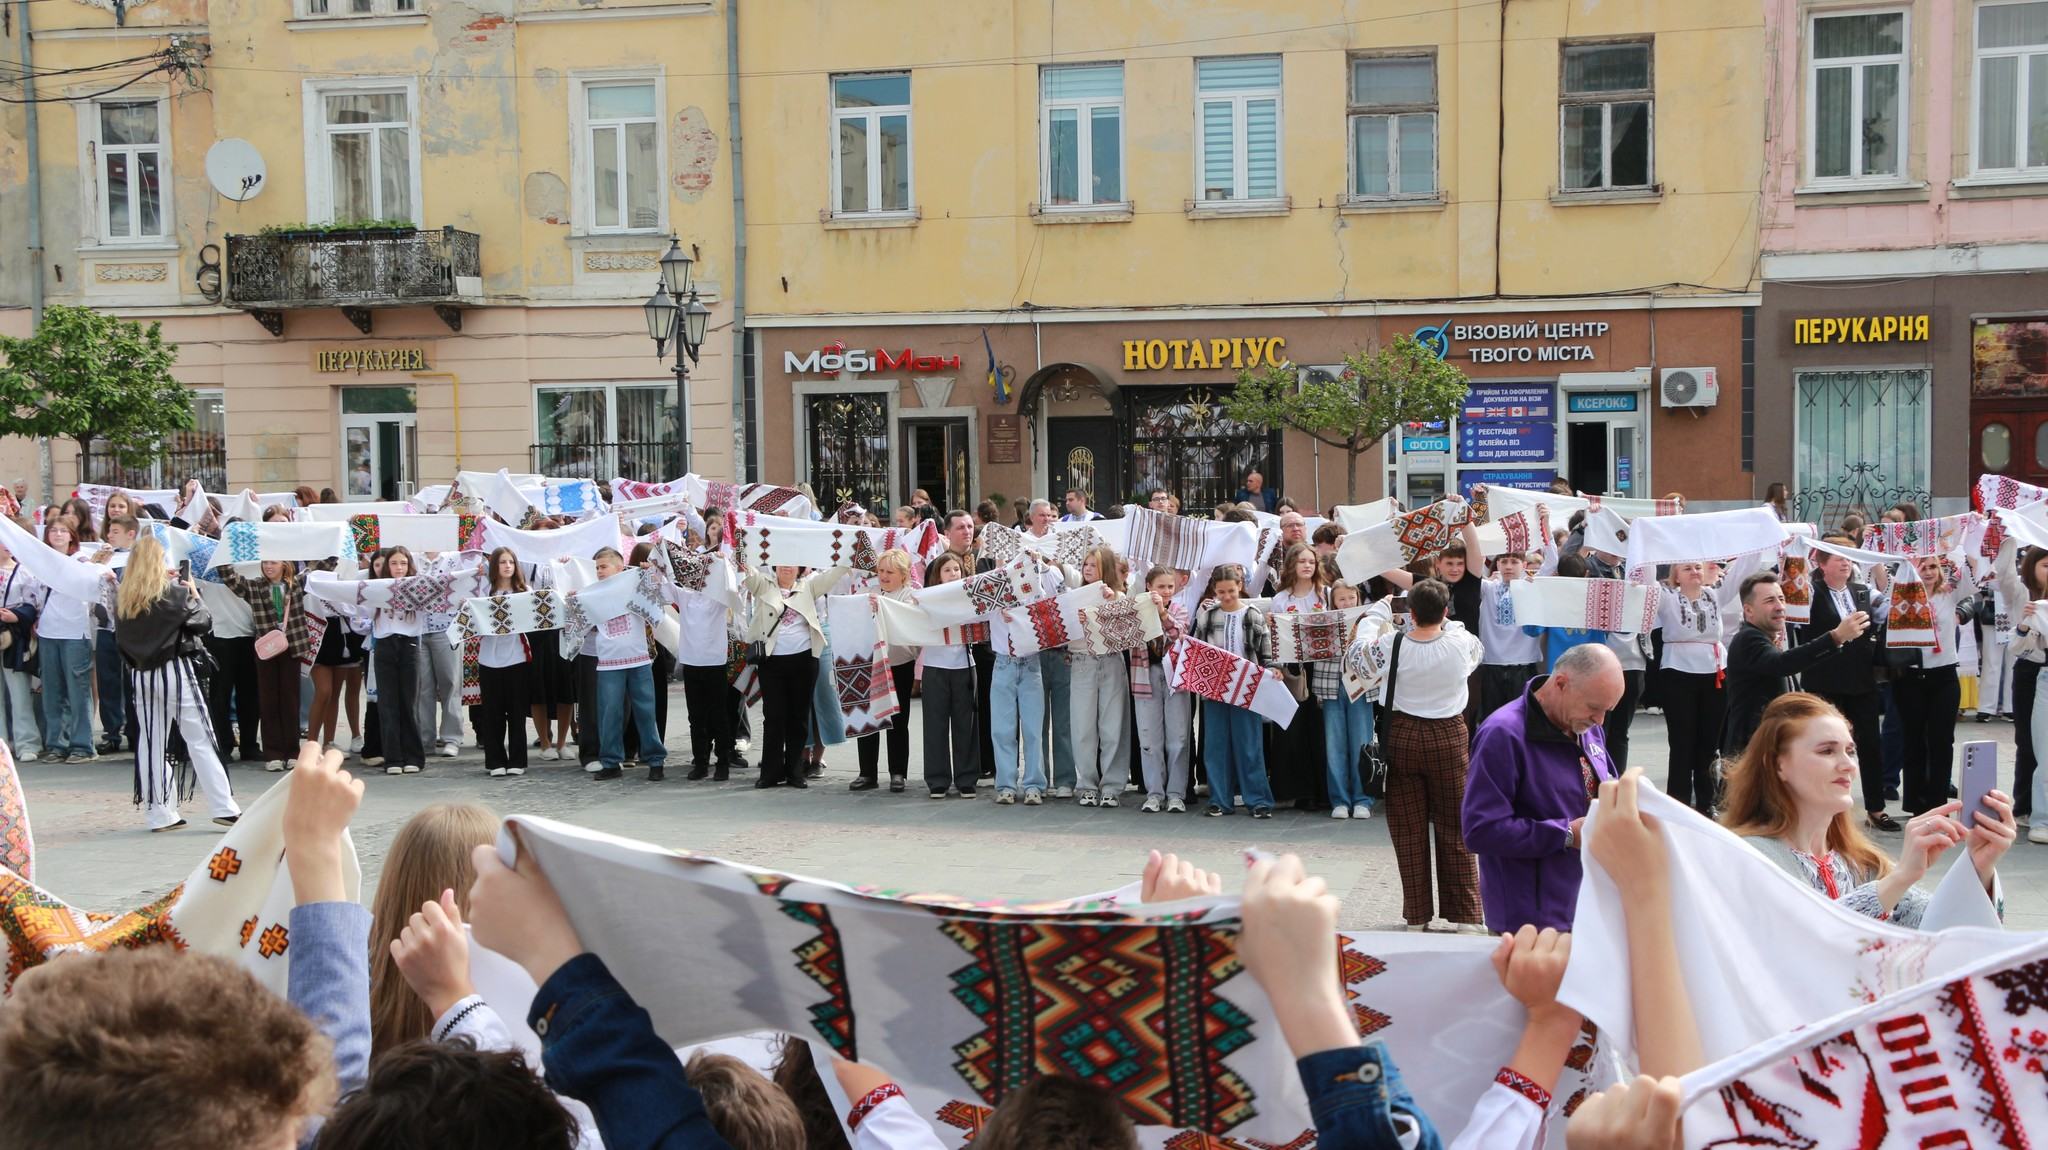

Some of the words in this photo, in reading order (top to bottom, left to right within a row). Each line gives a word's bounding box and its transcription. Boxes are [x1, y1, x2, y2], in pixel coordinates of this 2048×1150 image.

[1454, 320, 1538, 340] ВІЗОВИЙ
[1544, 322, 1609, 340] ЦЕНТР
[1795, 315, 1929, 344] ПЕРУКАРНЯ
[1122, 336, 1288, 370] НОТАРІУС
[1469, 346, 1532, 363] ТВОГО
[1537, 345, 1595, 361] МІСТА
[316, 349, 424, 376] ПЕРУКАРНЯ
[1509, 388, 1549, 396] ОФОРМЛЕННЯ
[1483, 396, 1519, 404] ДОКУМЕНТІВ
[1577, 396, 1628, 410] КСЕРОКС
[1478, 428, 1518, 436] РЕЄСТРАЦІЯ
[1409, 440, 1444, 450] ФОТО
[1478, 437, 1509, 447] ВКЛЕЙКА
[1509, 438, 1520, 446] ВІЗ
[1494, 450, 1509, 458] ДЛЯ
[1509, 449, 1545, 458] ІНОЗЕМЦІВ
[1482, 472, 1533, 480] СТРАХУВАННЯ
